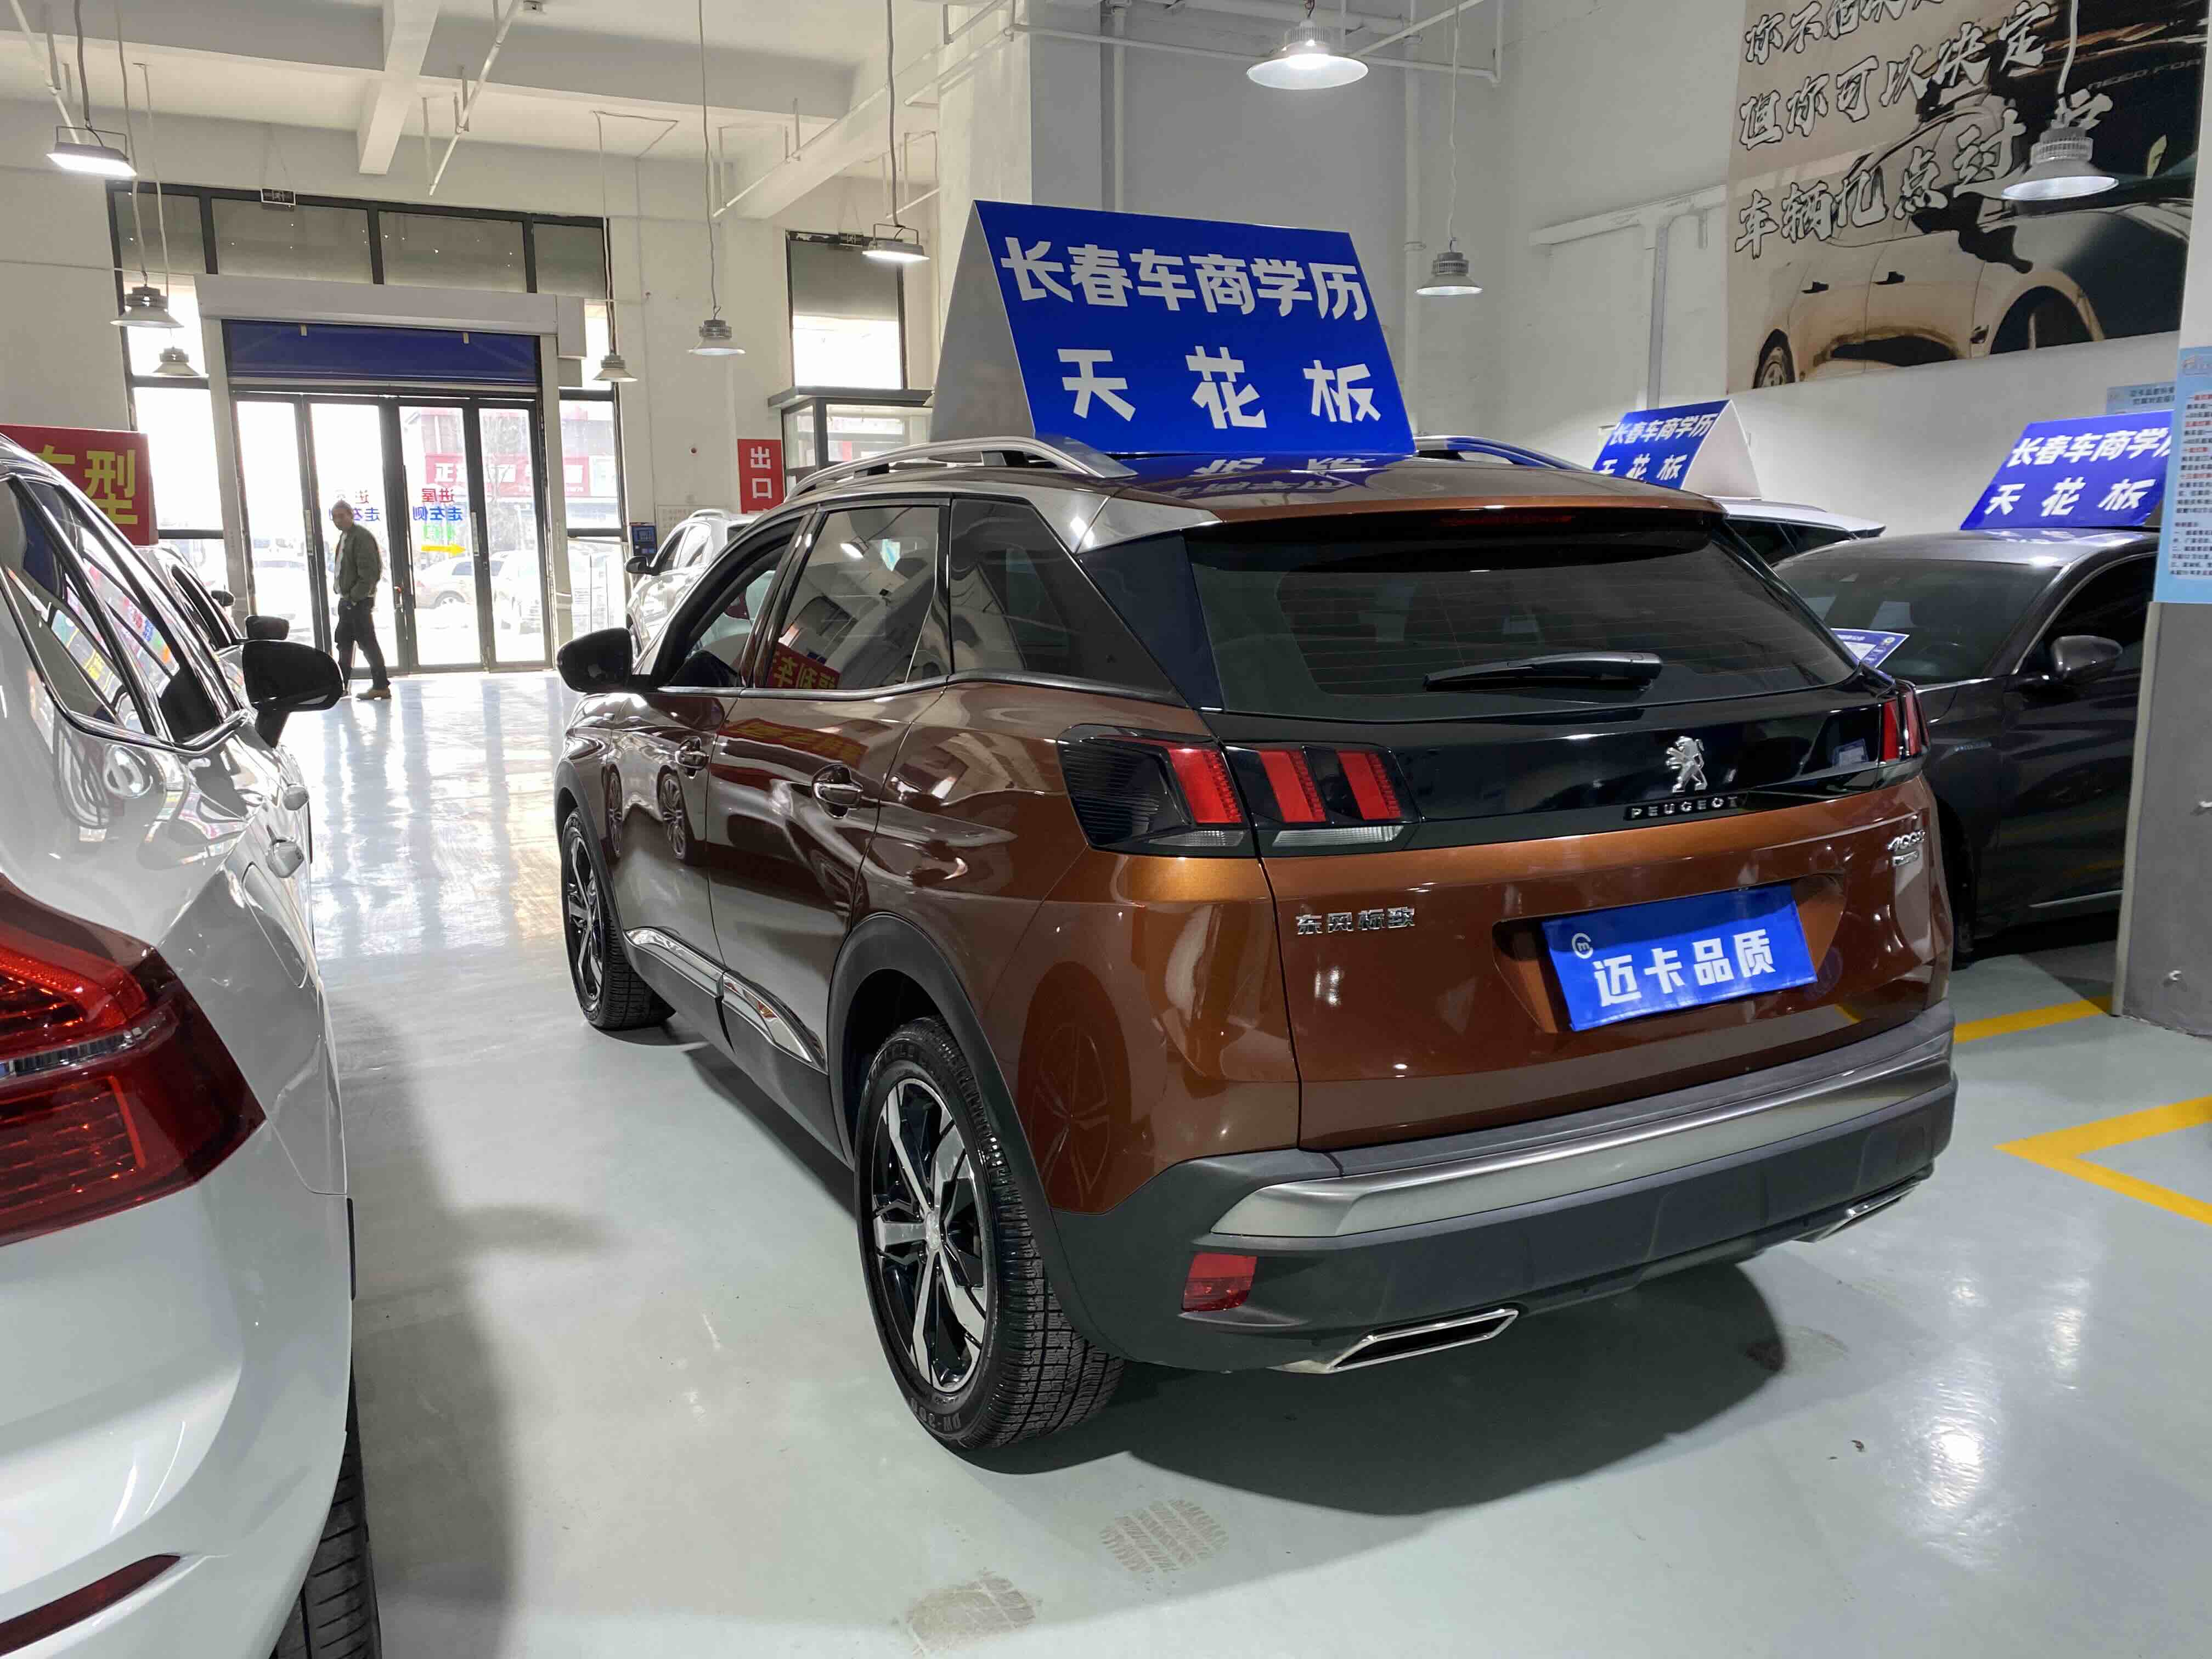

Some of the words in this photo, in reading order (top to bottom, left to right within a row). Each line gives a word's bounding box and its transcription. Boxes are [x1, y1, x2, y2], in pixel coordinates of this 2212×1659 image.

[1001, 236, 1369, 322] 长春车商学历
[1610, 413, 1718, 445] 长春车商学历
[750, 445, 772, 499] 出口
[1630, 795, 1739, 820] PEUGEOT
[1295, 906, 1415, 935] 东风标致
[1593, 929, 1776, 1008] 迈卡品质
